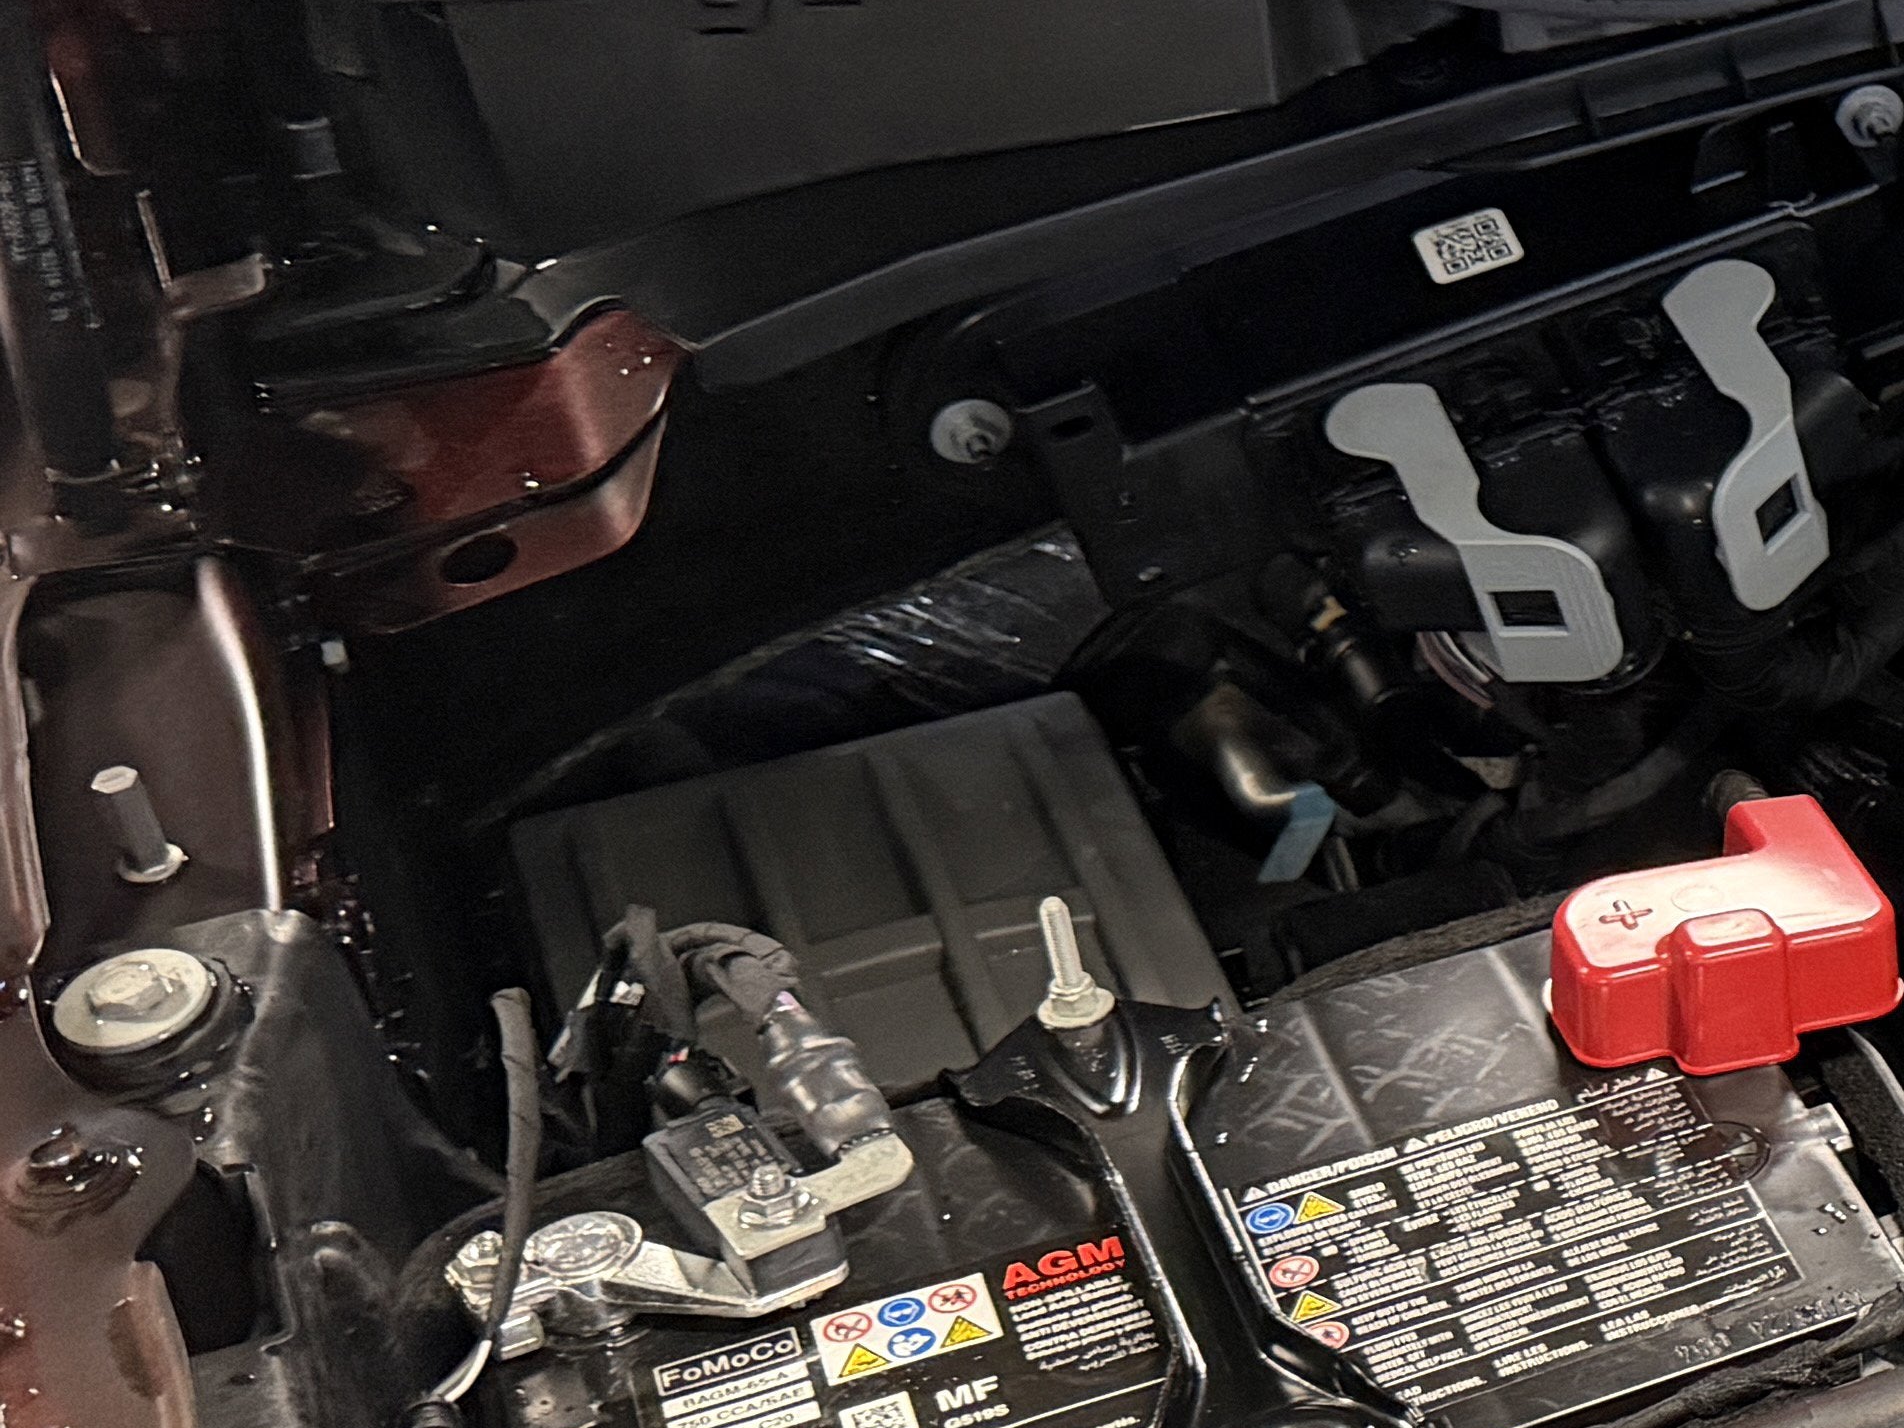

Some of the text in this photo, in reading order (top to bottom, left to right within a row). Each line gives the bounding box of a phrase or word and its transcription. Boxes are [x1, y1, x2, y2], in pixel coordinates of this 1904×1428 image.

[1003, 1237, 1124, 1289] AGM
[1005, 1260, 1124, 1299] TECHNOLOGY
[661, 1336, 796, 1387] FoMoCo
[935, 1376, 998, 1412] MF
[759, 1414, 794, 1428] C20
